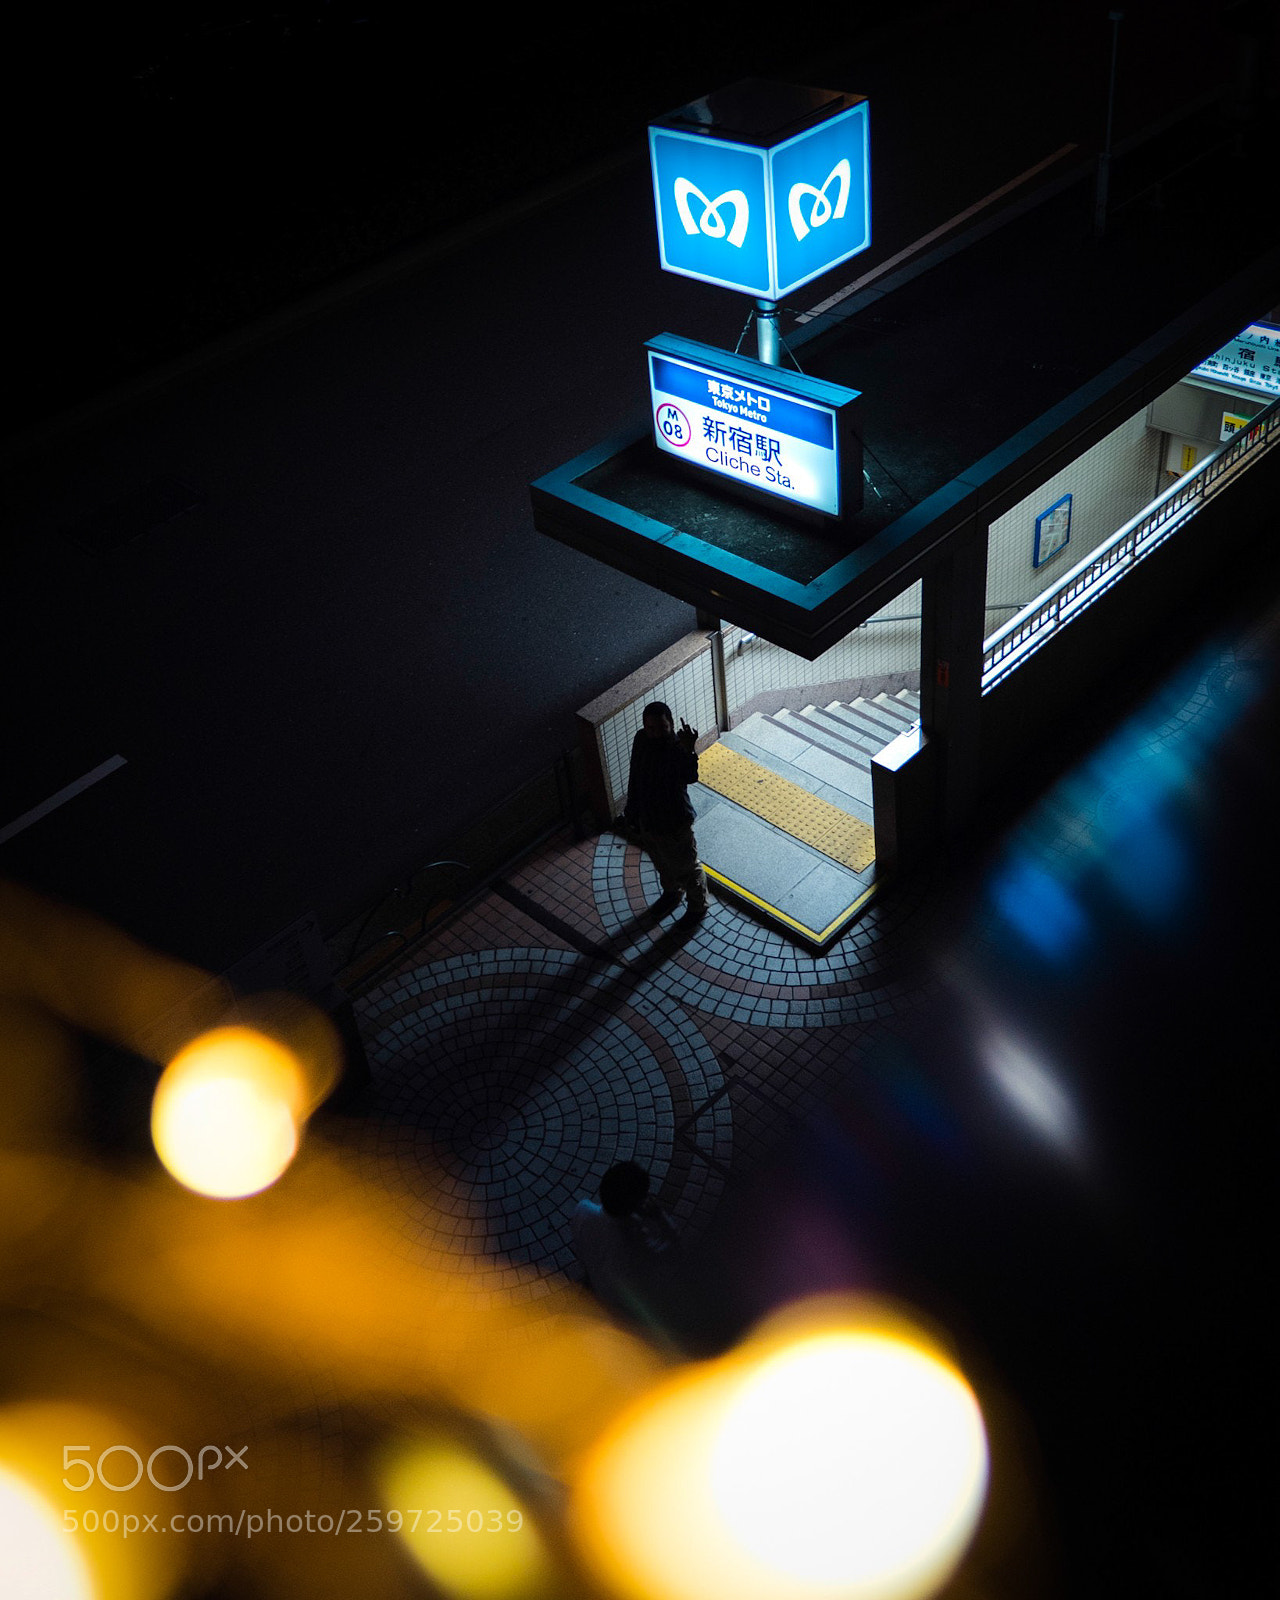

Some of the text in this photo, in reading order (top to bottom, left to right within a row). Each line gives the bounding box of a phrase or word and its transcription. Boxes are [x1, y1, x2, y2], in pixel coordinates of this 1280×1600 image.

[707, 379, 770, 412] 東京メトロ
[712, 395, 767, 423] Tokyo Metro
[663, 420, 683, 439] 08
[667, 408, 679, 421] M
[702, 415, 783, 467] 新宿駅
[705, 447, 795, 490] Cliche Sta.
